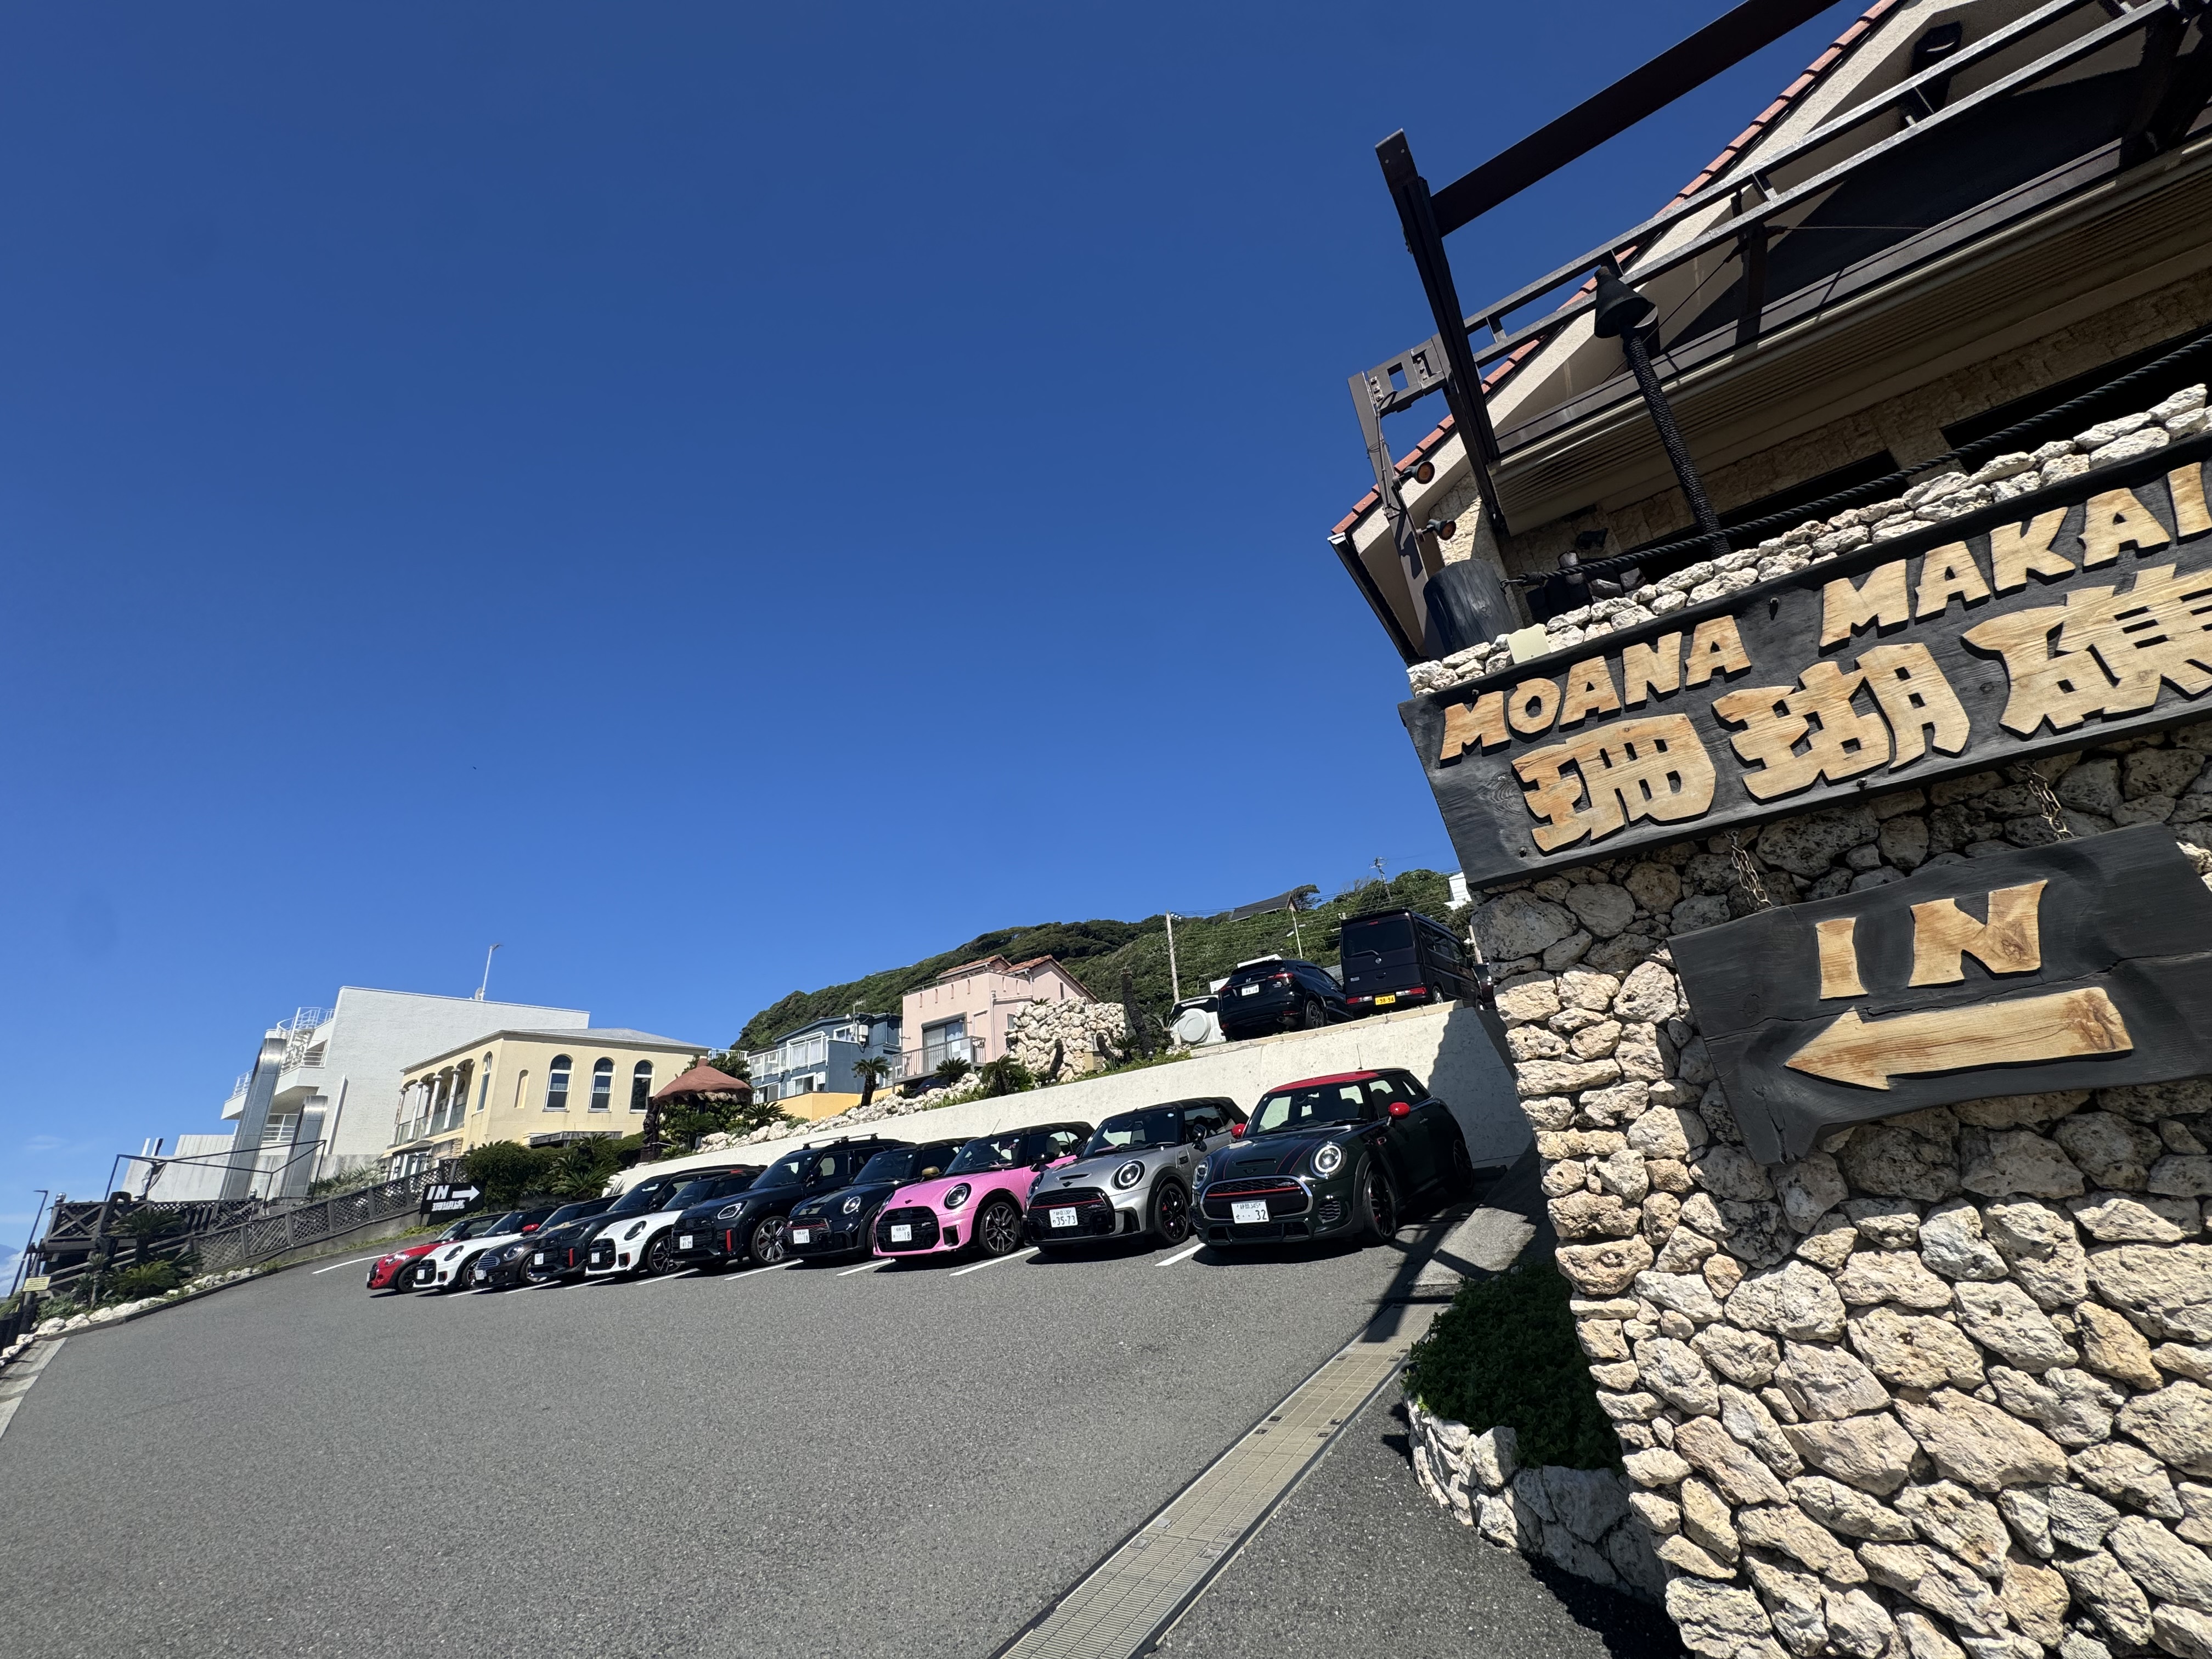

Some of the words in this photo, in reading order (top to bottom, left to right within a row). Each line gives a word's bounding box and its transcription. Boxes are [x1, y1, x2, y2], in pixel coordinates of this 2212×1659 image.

[1440, 614, 1752, 761] MOANA
[1818, 461, 2212, 649] MAKAI
[1815, 879, 2049, 1000] IN
[426, 1185, 450, 1200] IN
[1056, 1215, 1076, 1225] 35-73
